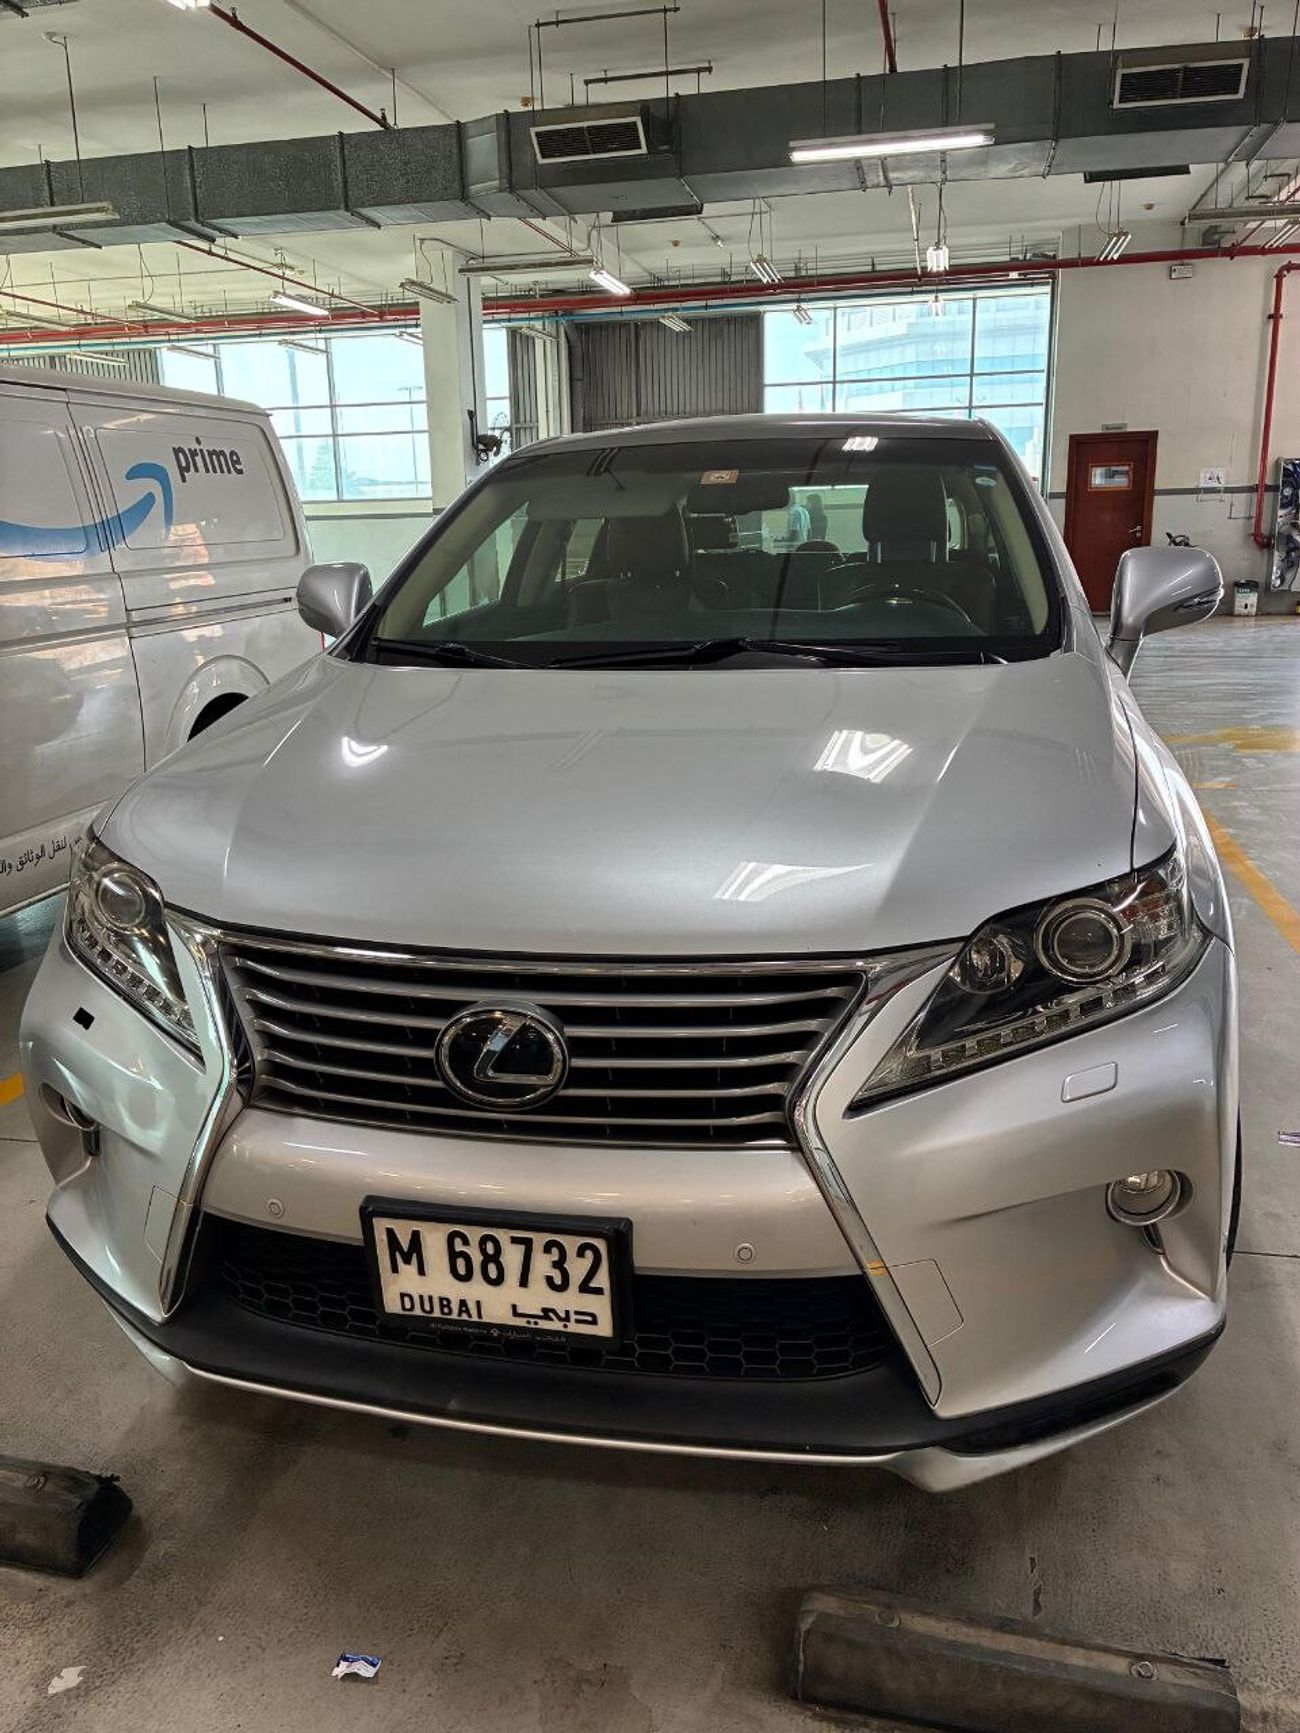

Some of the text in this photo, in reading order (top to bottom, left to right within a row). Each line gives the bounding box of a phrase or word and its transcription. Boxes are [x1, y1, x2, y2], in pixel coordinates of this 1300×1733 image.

[172, 436, 244, 483] prime
[385, 1227, 605, 1296] M 68732
[399, 1292, 483, 1320] DUBAI
[511, 1303, 599, 1329] دبي
